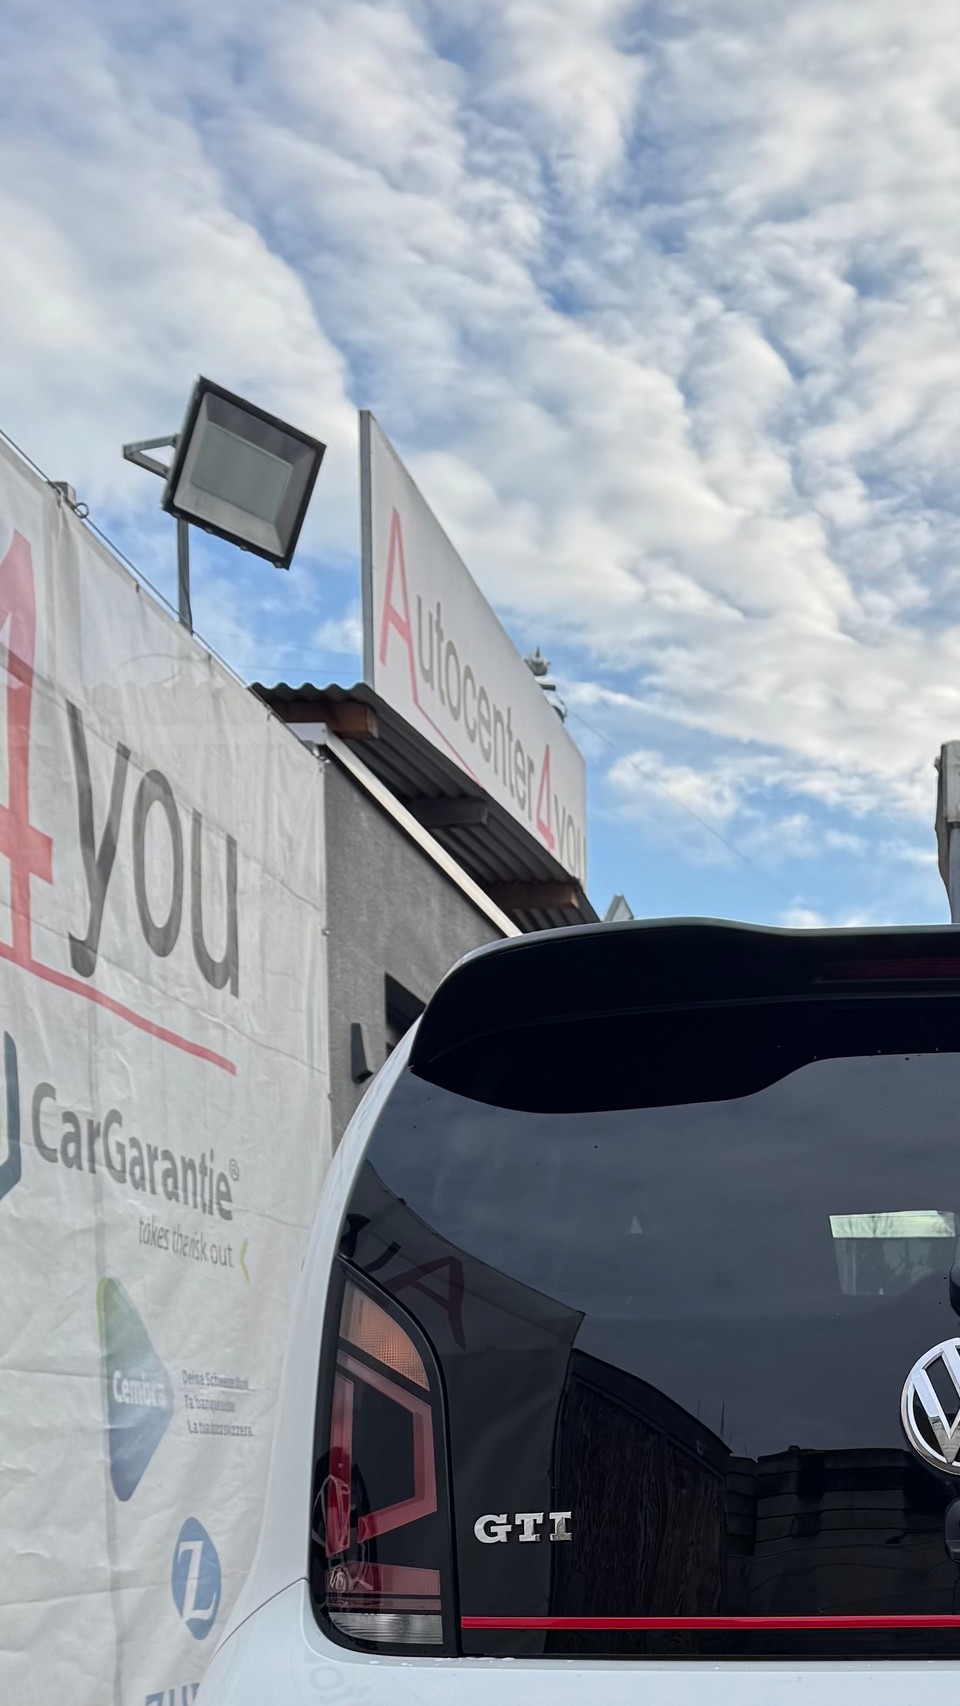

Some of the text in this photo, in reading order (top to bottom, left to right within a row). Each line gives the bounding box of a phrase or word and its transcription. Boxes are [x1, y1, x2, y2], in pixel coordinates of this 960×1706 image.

[139, 1214, 169, 1250] takes
[210, 1243, 234, 1268] out
[474, 1511, 573, 1544] GTI
